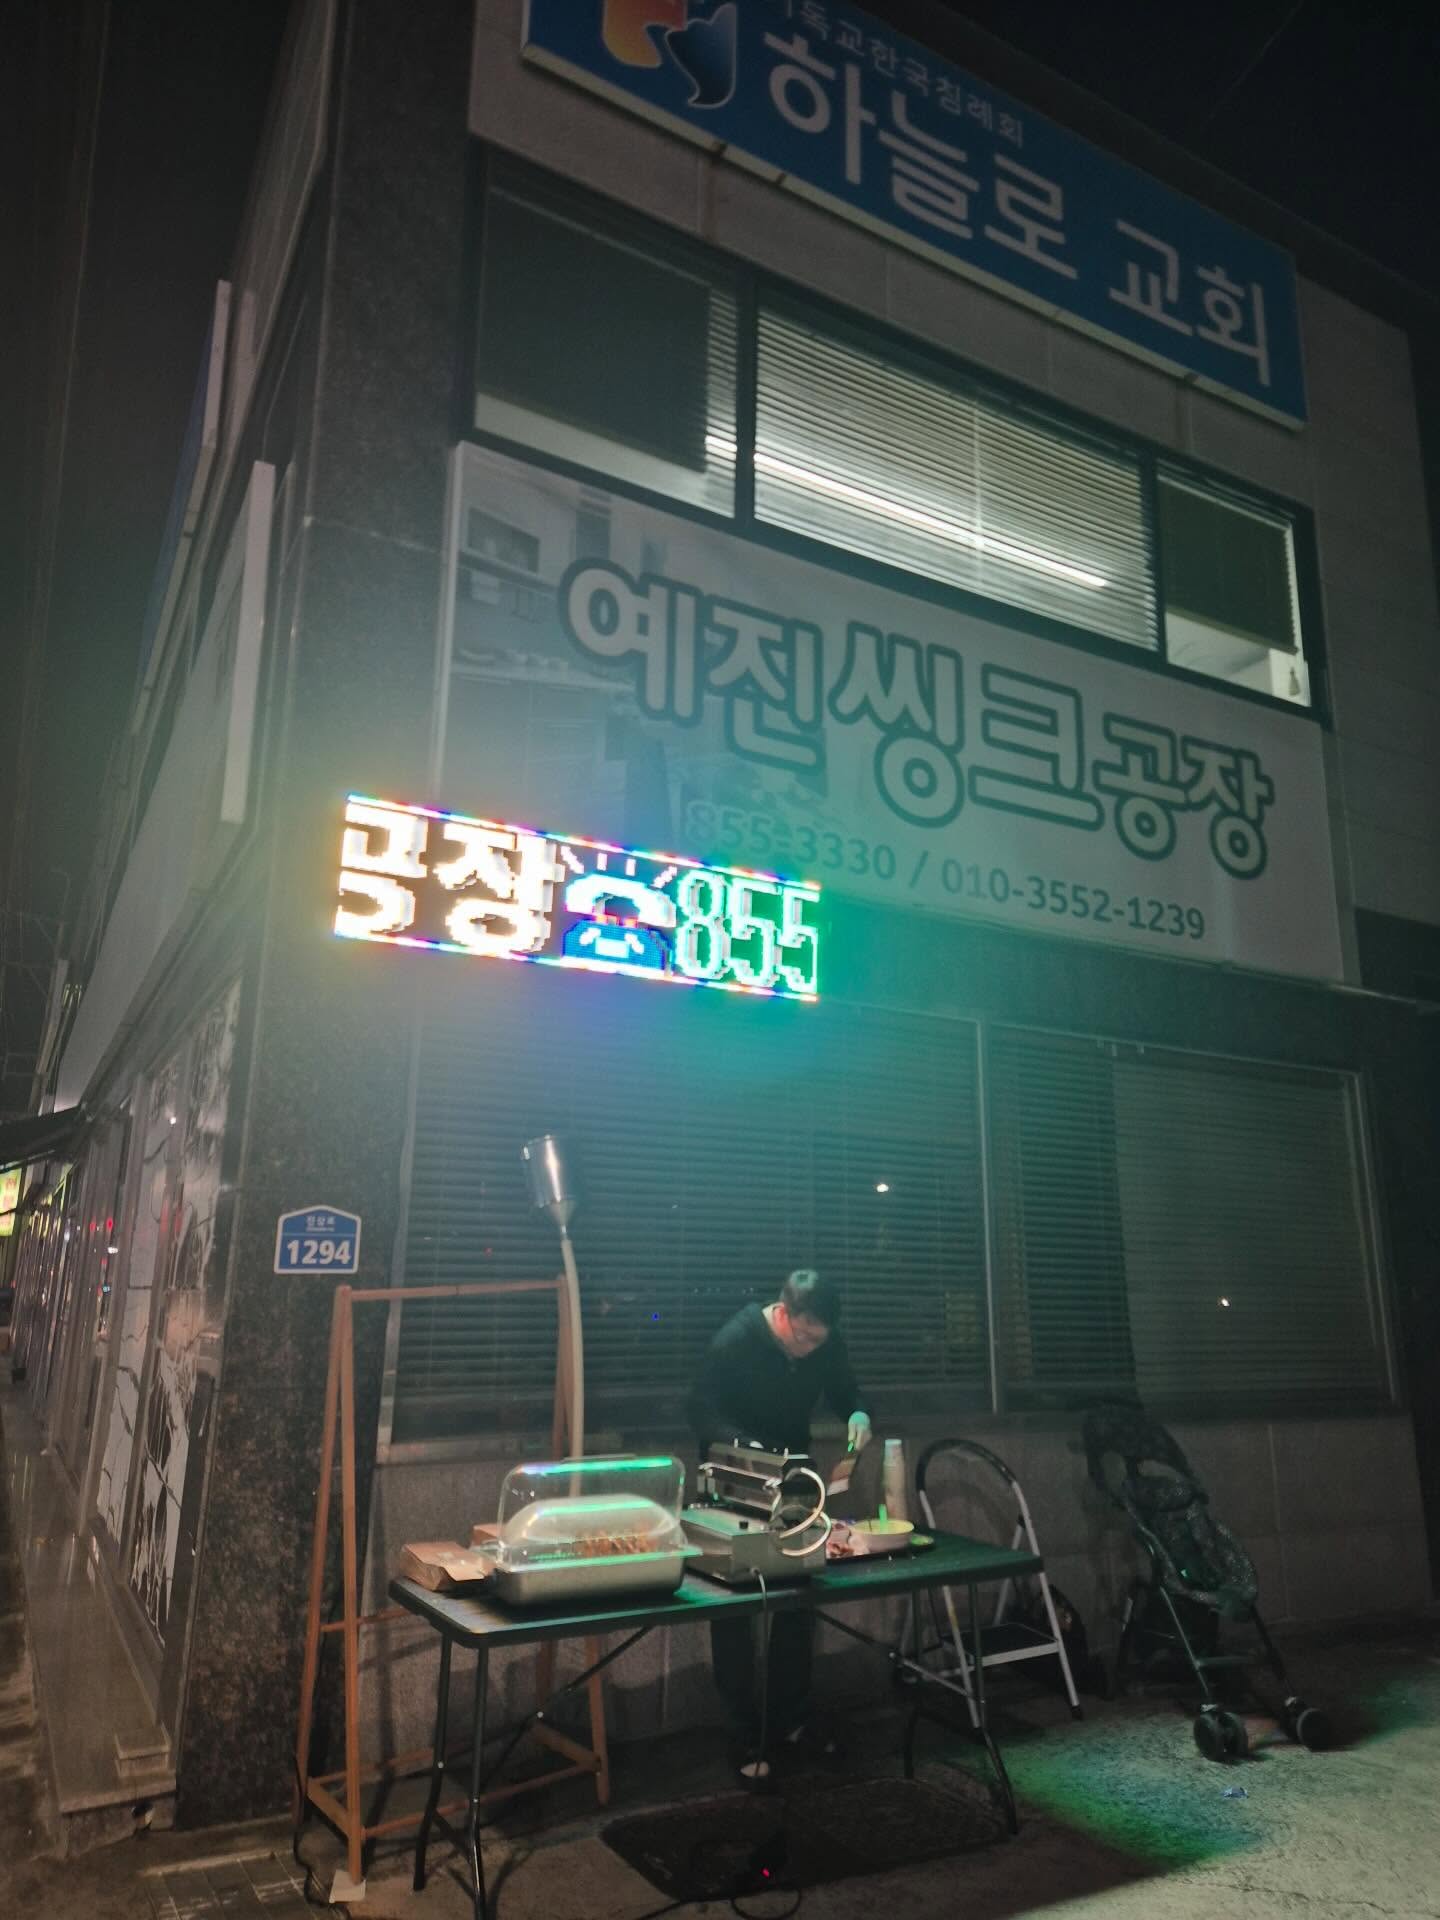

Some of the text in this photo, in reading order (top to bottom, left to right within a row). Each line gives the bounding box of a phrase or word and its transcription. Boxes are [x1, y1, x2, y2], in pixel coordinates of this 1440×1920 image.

[763, 31, 1272, 387] 하늘로 교회
[685, 799, 898, 881] 855-3330
[940, 857, 1206, 941] 010-3552-1239
[287, 1239, 352, 1265] 1294
